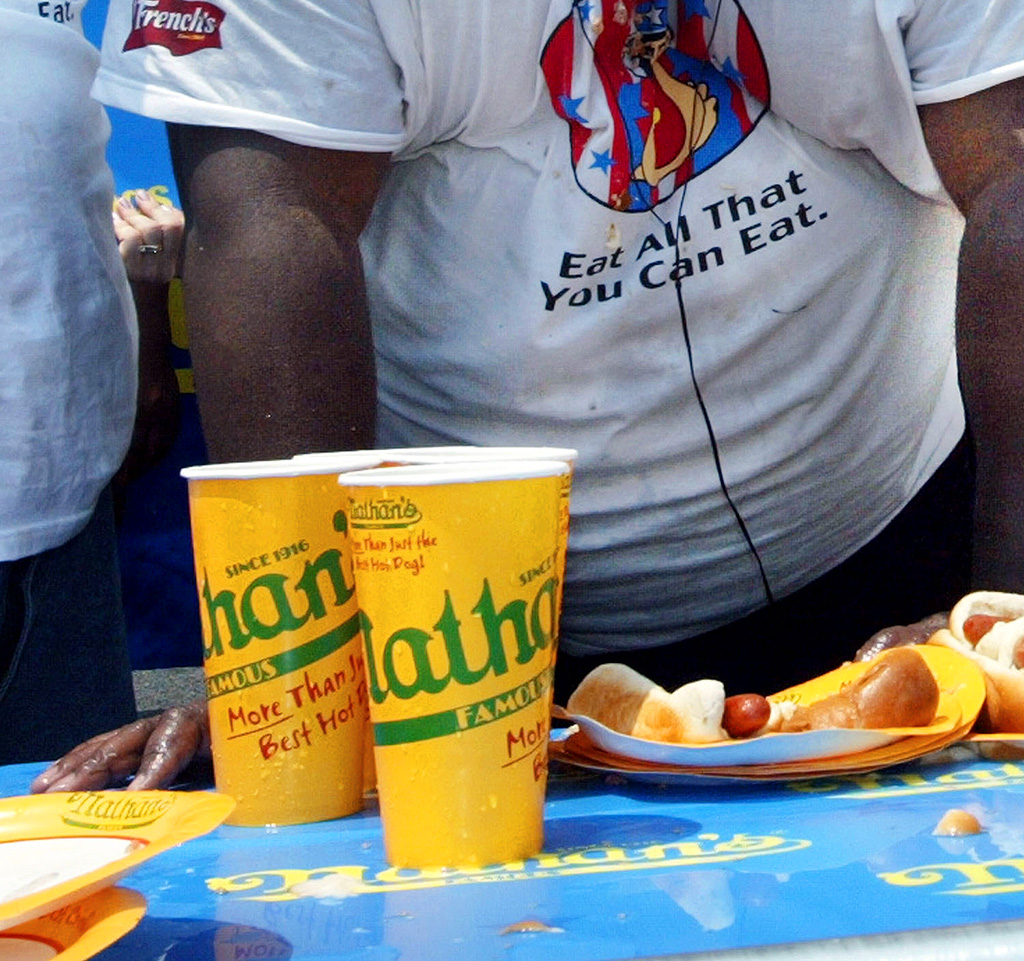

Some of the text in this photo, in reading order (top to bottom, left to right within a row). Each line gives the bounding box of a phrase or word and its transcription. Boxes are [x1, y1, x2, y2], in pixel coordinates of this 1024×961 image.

[135, 0, 217, 34] French's
[559, 169, 808, 279] Eat All That
[540, 202, 828, 311] You Can Eat.
[225, 539, 310, 578] SINCE 1916
[227, 701, 284, 733] More
[286, 670, 346, 708] Than
[259, 724, 313, 760] Best
[315, 695, 354, 735] Hot
